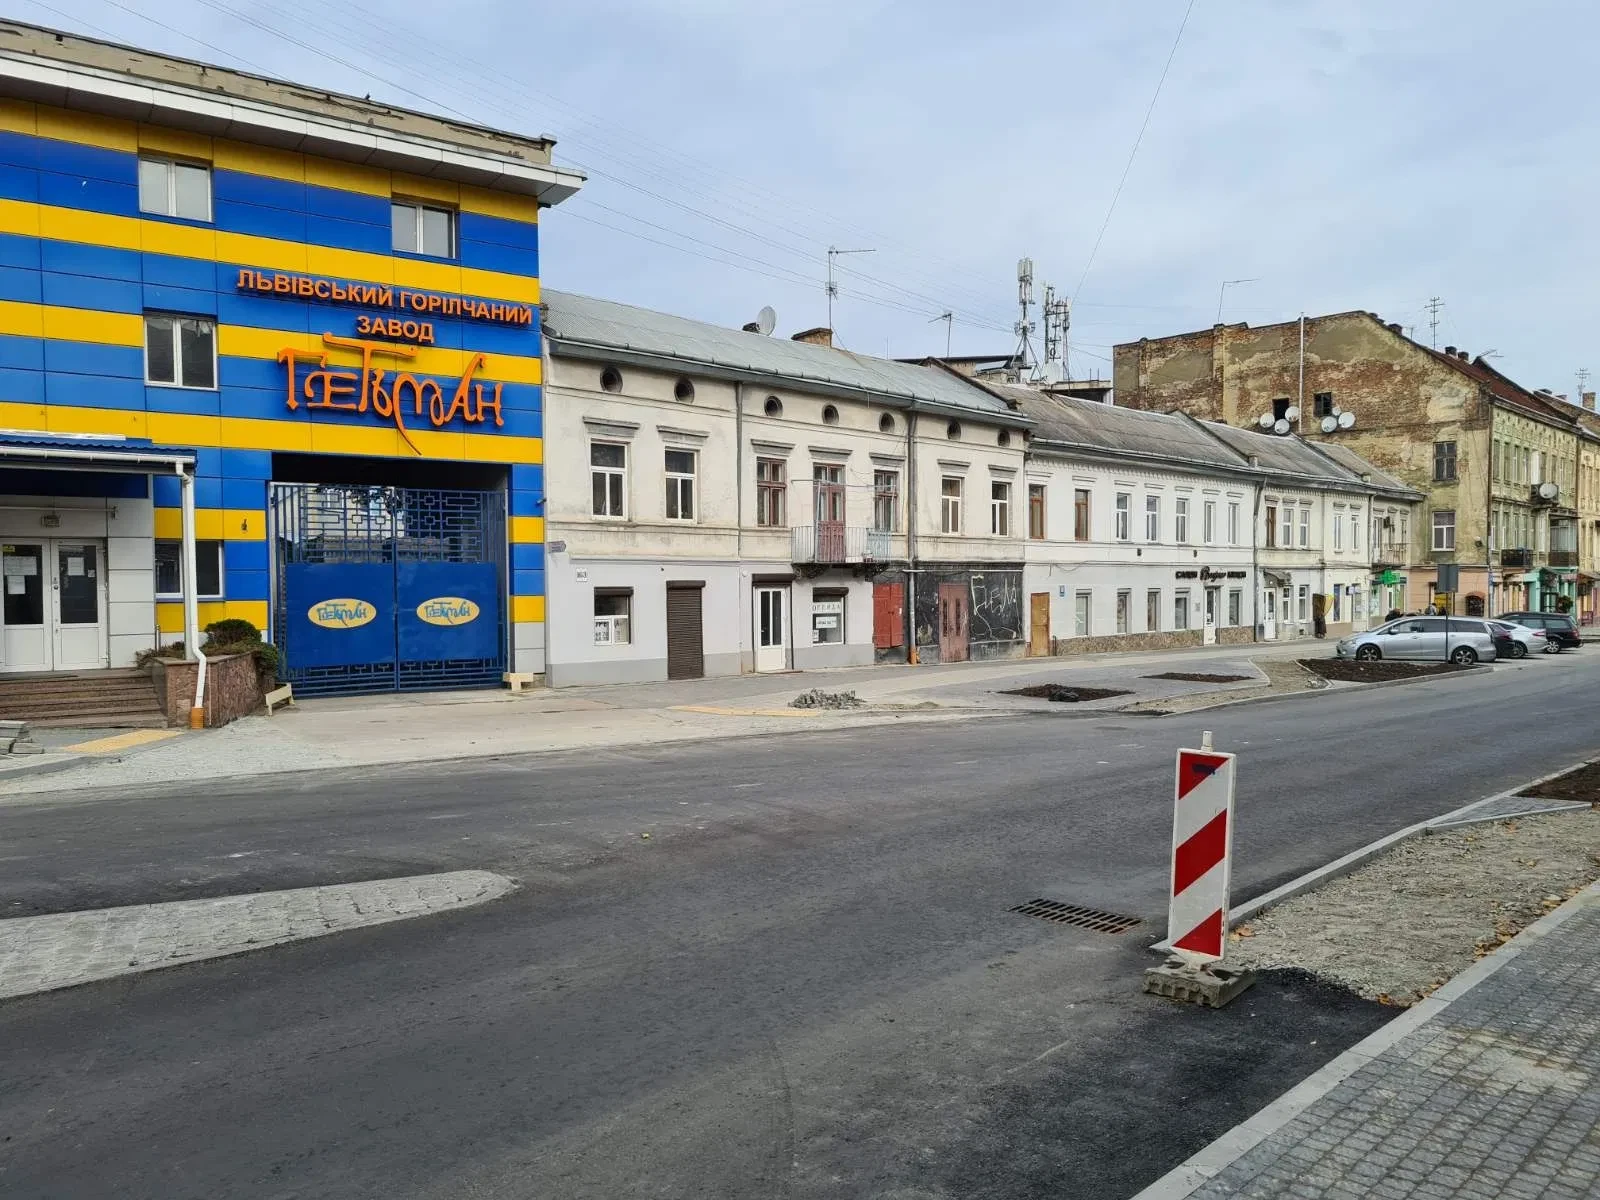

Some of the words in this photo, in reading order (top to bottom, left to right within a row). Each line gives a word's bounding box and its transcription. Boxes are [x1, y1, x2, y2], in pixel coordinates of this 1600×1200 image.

[236, 268, 393, 307] ЛЬВІВСЬКИЙ
[400, 291, 532, 325] ГОРІЛЧАНИЙ
[356, 315, 435, 344] ЗАВОД
